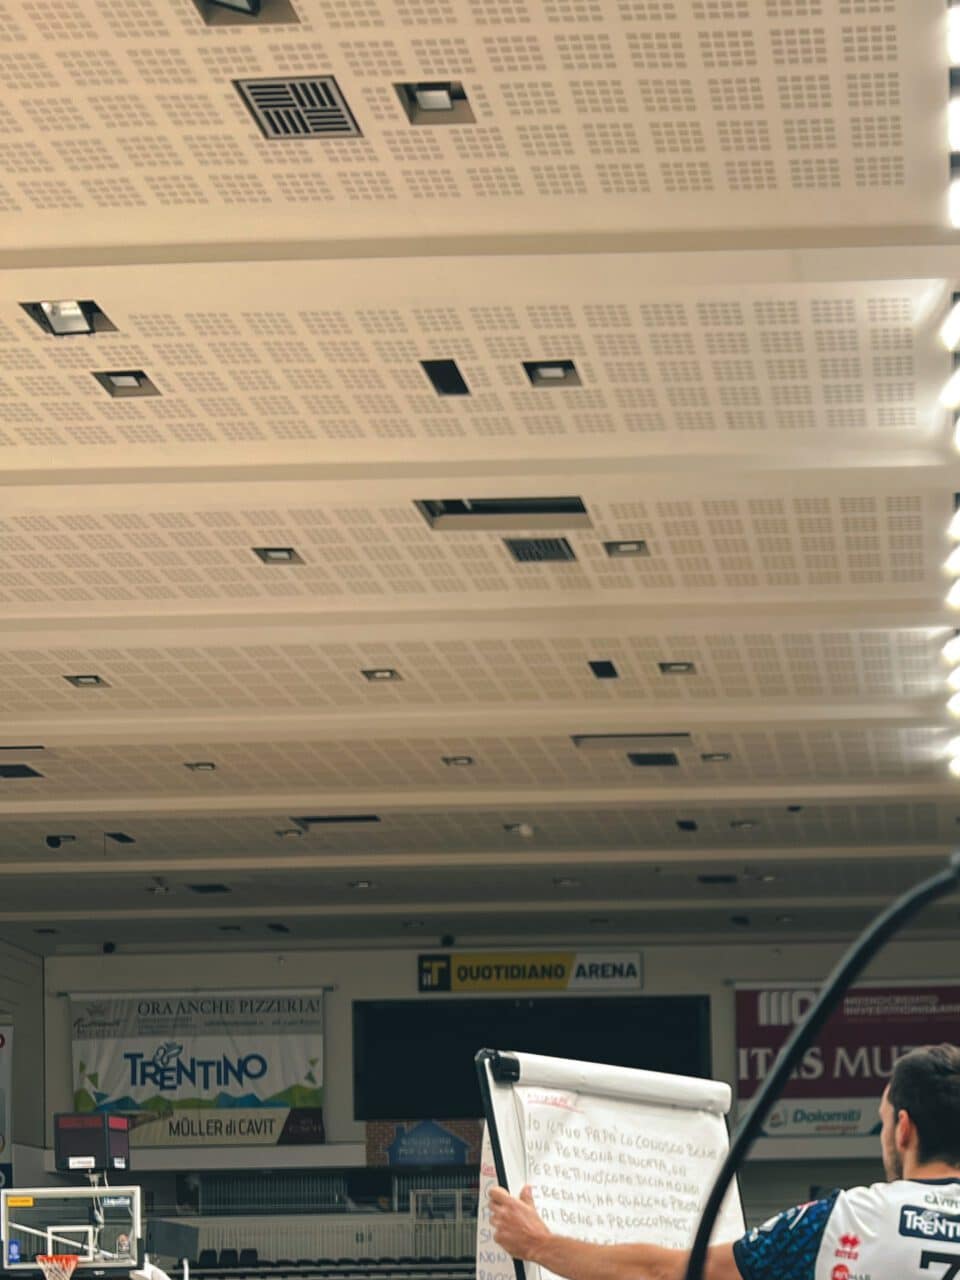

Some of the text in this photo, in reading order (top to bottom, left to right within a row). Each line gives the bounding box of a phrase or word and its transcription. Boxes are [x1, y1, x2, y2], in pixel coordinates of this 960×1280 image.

[457, 964, 566, 982] QUOTIDIANO
[575, 962, 638, 980] ARENA
[137, 999, 321, 1016] ORA ANCHE PIZZERIA!
[123, 1051, 268, 1091] TRENTINO
[793, 1108, 862, 1123] Dolomiti
[168, 1118, 223, 1137] MÜLLER
[225, 1119, 237, 1135] di
[238, 1118, 277, 1136] CAVIT
